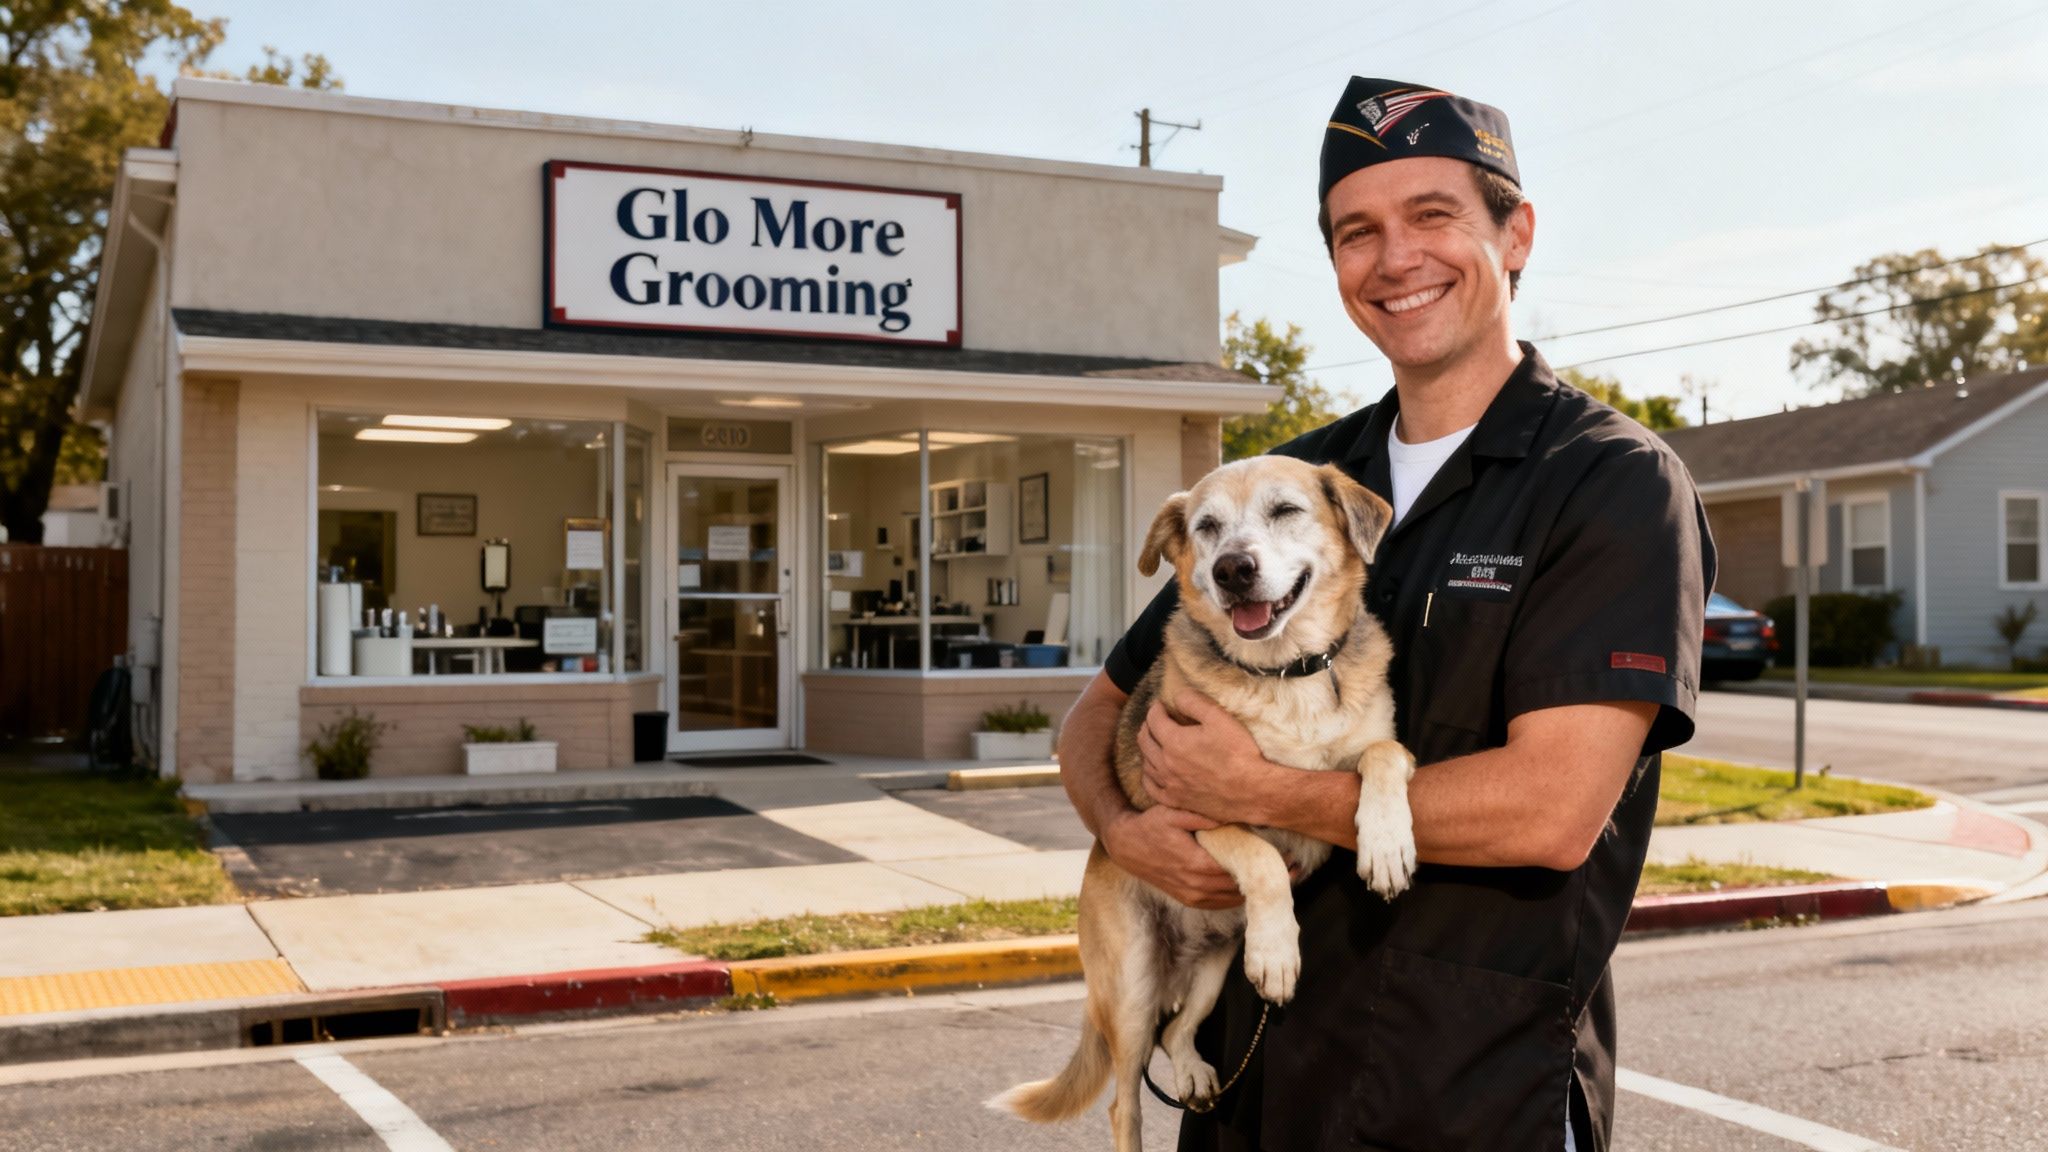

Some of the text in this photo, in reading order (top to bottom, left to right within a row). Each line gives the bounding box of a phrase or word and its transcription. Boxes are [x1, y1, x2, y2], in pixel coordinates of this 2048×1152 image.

[616, 187, 905, 256] Glo More
[610, 252, 913, 332] Grooming
